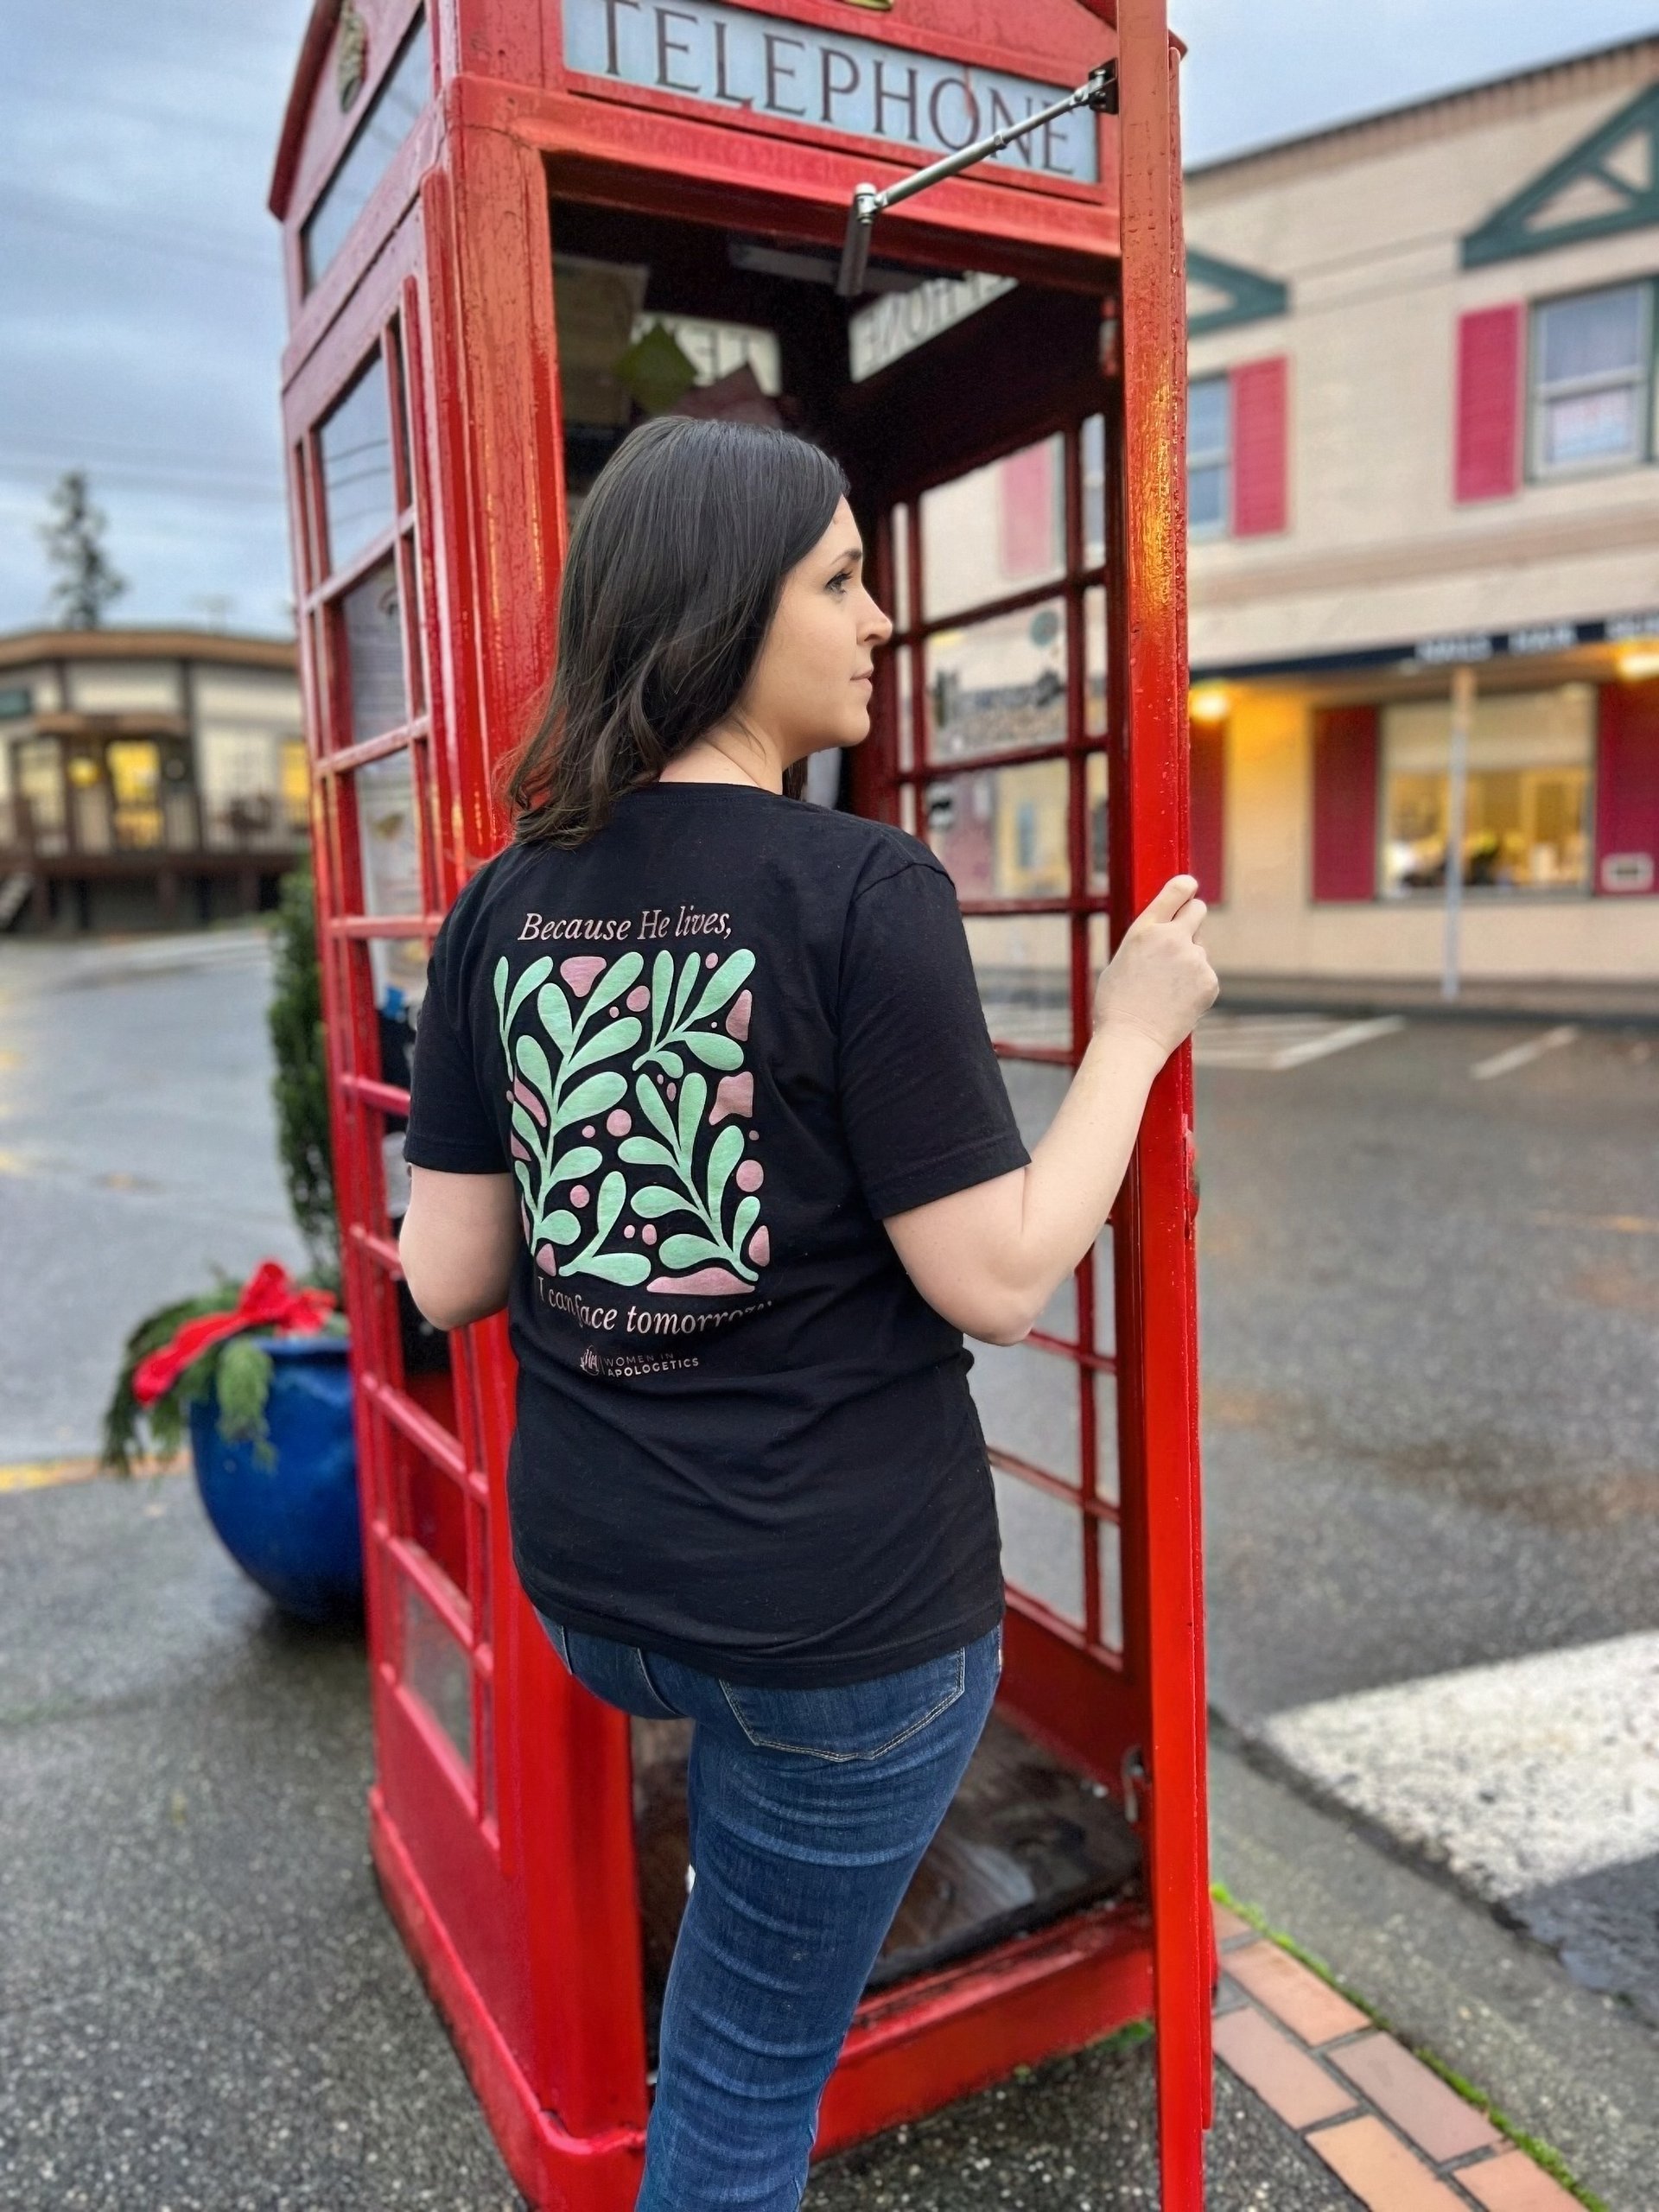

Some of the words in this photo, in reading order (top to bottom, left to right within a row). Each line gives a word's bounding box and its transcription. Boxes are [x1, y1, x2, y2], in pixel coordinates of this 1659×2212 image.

[589, 0, 1074, 175] TELEPHONE
[518, 912, 632, 941] Because
[637, 910, 671, 940] He
[674, 906, 733, 940] lives,
[537, 1275, 545, 1301] I
[626, 1300, 772, 1335] tomorr
[604, 1354, 655, 1367] WOMEN
[659, 1351, 675, 1361] IN
[607, 1357, 700, 1378] APOLOGETICS
